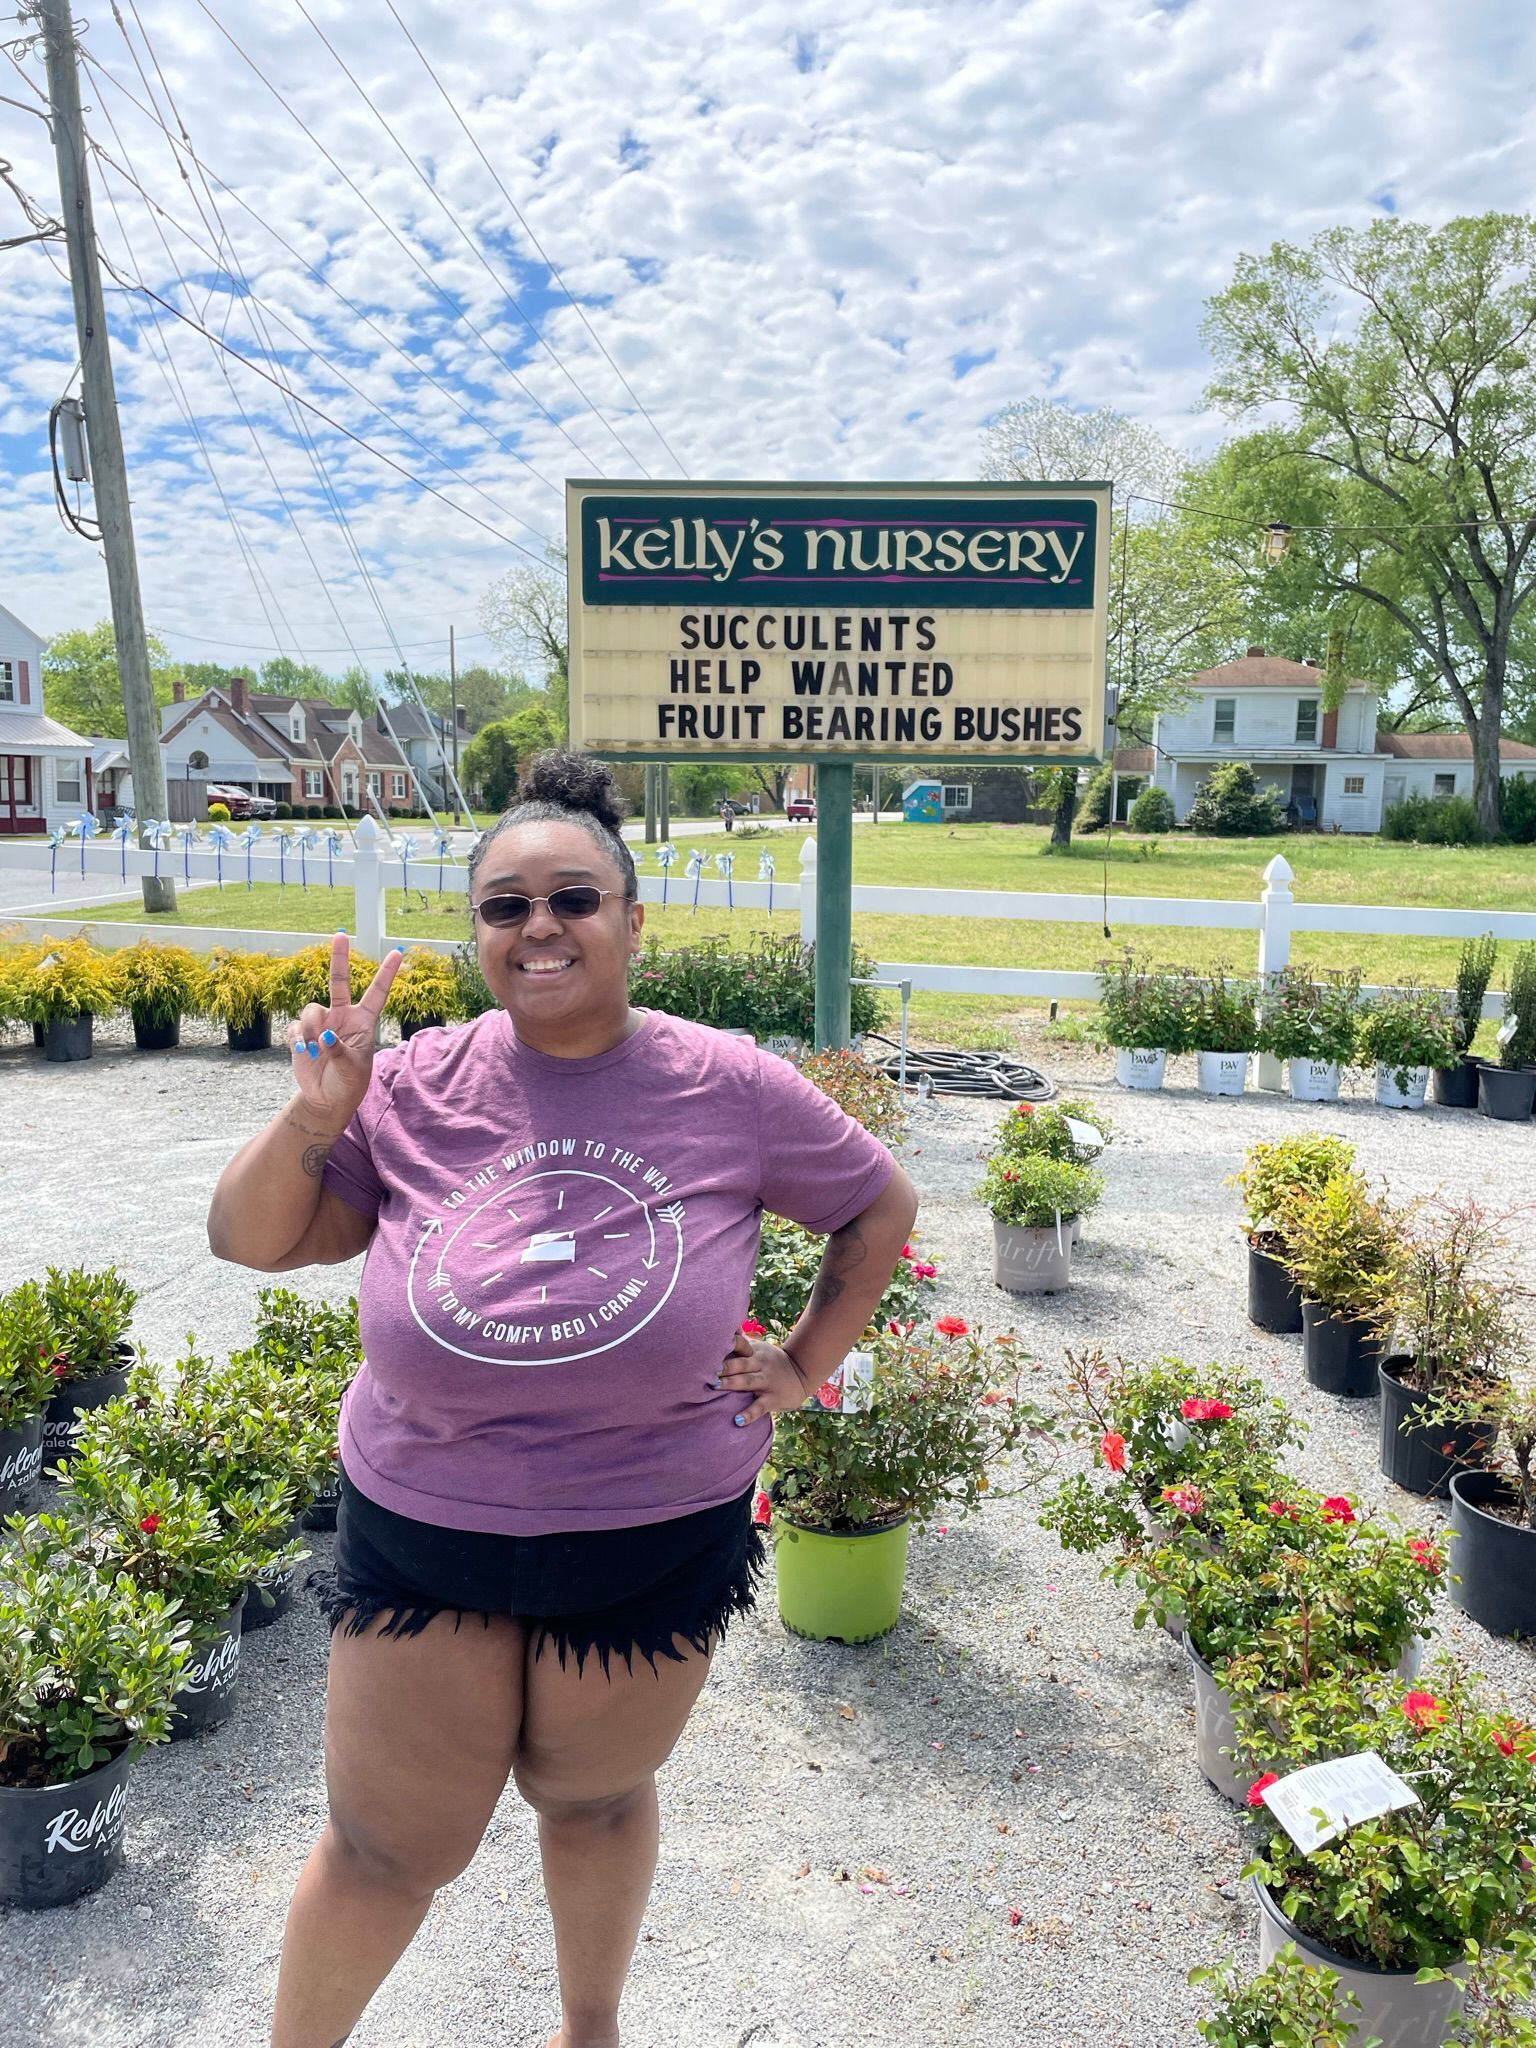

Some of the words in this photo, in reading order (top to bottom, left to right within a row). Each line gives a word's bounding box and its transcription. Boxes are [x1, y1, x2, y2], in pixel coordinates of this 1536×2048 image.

[680, 615, 937, 652] SUCCULENTS
[670, 659, 761, 695] HELP
[792, 661, 954, 697] WANTED
[658, 704, 766, 740] FRUIT
[783, 706, 942, 742] BEARING
[954, 706, 1083, 742] BUSHES
[441, 1190, 467, 1210] TO
[464, 1165, 499, 1192] THE
[502, 1138, 576, 1172] WINDOW
[584, 1139, 606, 1159] TO
[611, 1147, 644, 1174] THE
[642, 1166, 673, 1196] WAL
[999, 1237, 1058, 1270] drift
[437, 1290, 459, 1312] TO
[452, 1306, 482, 1331] MY
[482, 1321, 544, 1344] COMFY
[551, 1318, 586, 1342] BED
[587, 1312, 598, 1329] I
[599, 1278, 649, 1322] CRAWL
